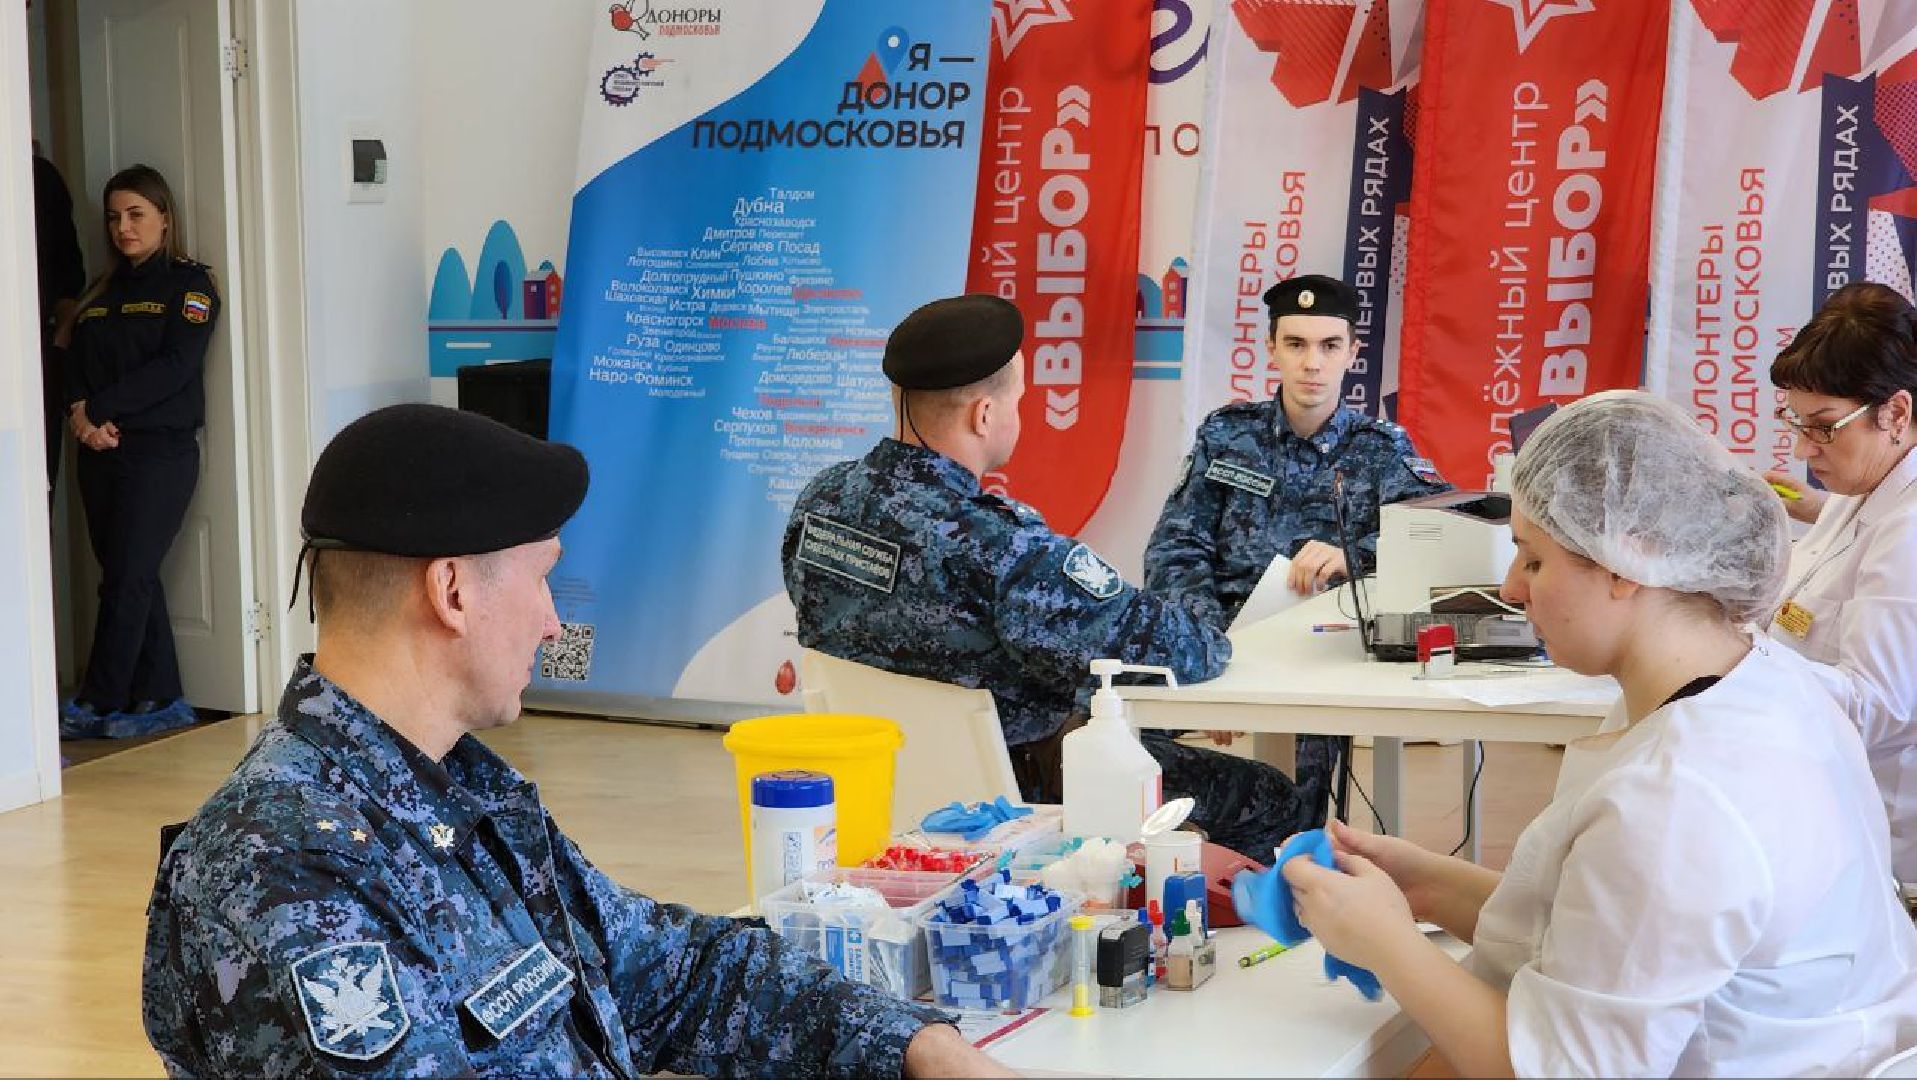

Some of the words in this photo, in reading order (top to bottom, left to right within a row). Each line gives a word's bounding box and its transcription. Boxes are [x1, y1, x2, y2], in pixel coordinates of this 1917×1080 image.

[646, 8, 720, 23] ДОНОРЫ
[659, 25, 720, 37] ПОДМОСКОВЬЯ
[908, 43, 931, 71] Я
[838, 81, 970, 116] ДОНОР
[693, 119, 965, 151] ПОДМОСКОВЬЯ
[994, 87, 1032, 224] центр
[1505, 82, 1549, 227] центр
[1831, 104, 1861, 212] РЯДАХ
[1361, 115, 1390, 216] РЯДАХ
[770, 187, 814, 201] Талдом
[733, 197, 785, 217] Дубна
[702, 227, 756, 241] Дмитров
[1538, 79, 1608, 400] ВЫБОР»
[691, 247, 721, 260] Клин
[721, 240, 775, 252] Сергиев
[778, 241, 821, 254] Посад
[626, 256, 683, 267] Лотошино
[742, 255, 779, 266] Лобня
[1033, 85, 1091, 430] «ВЫБОР»
[640, 270, 728, 284] Долгопрудный
[731, 268, 785, 282] Пушкино
[611, 280, 689, 294] Волоколамск
[691, 284, 736, 299] Химки
[669, 299, 706, 313] Истра
[747, 301, 800, 317] Мытищи
[626, 311, 704, 327] Красногорск
[1693, 225, 1724, 435] ОЛОНТЕРЫ
[626, 334, 660, 349] Руза
[663, 340, 721, 354] Одинцово
[593, 356, 653, 369] Можайск
[786, 350, 848, 362] Люберцы
[590, 368, 694, 387] Наро-Фоминск
[732, 407, 773, 420] Чехов
[714, 420, 778, 435] Серпухов
[784, 436, 843, 448] Коломна
[482, 989, 520, 1024] ФССП
